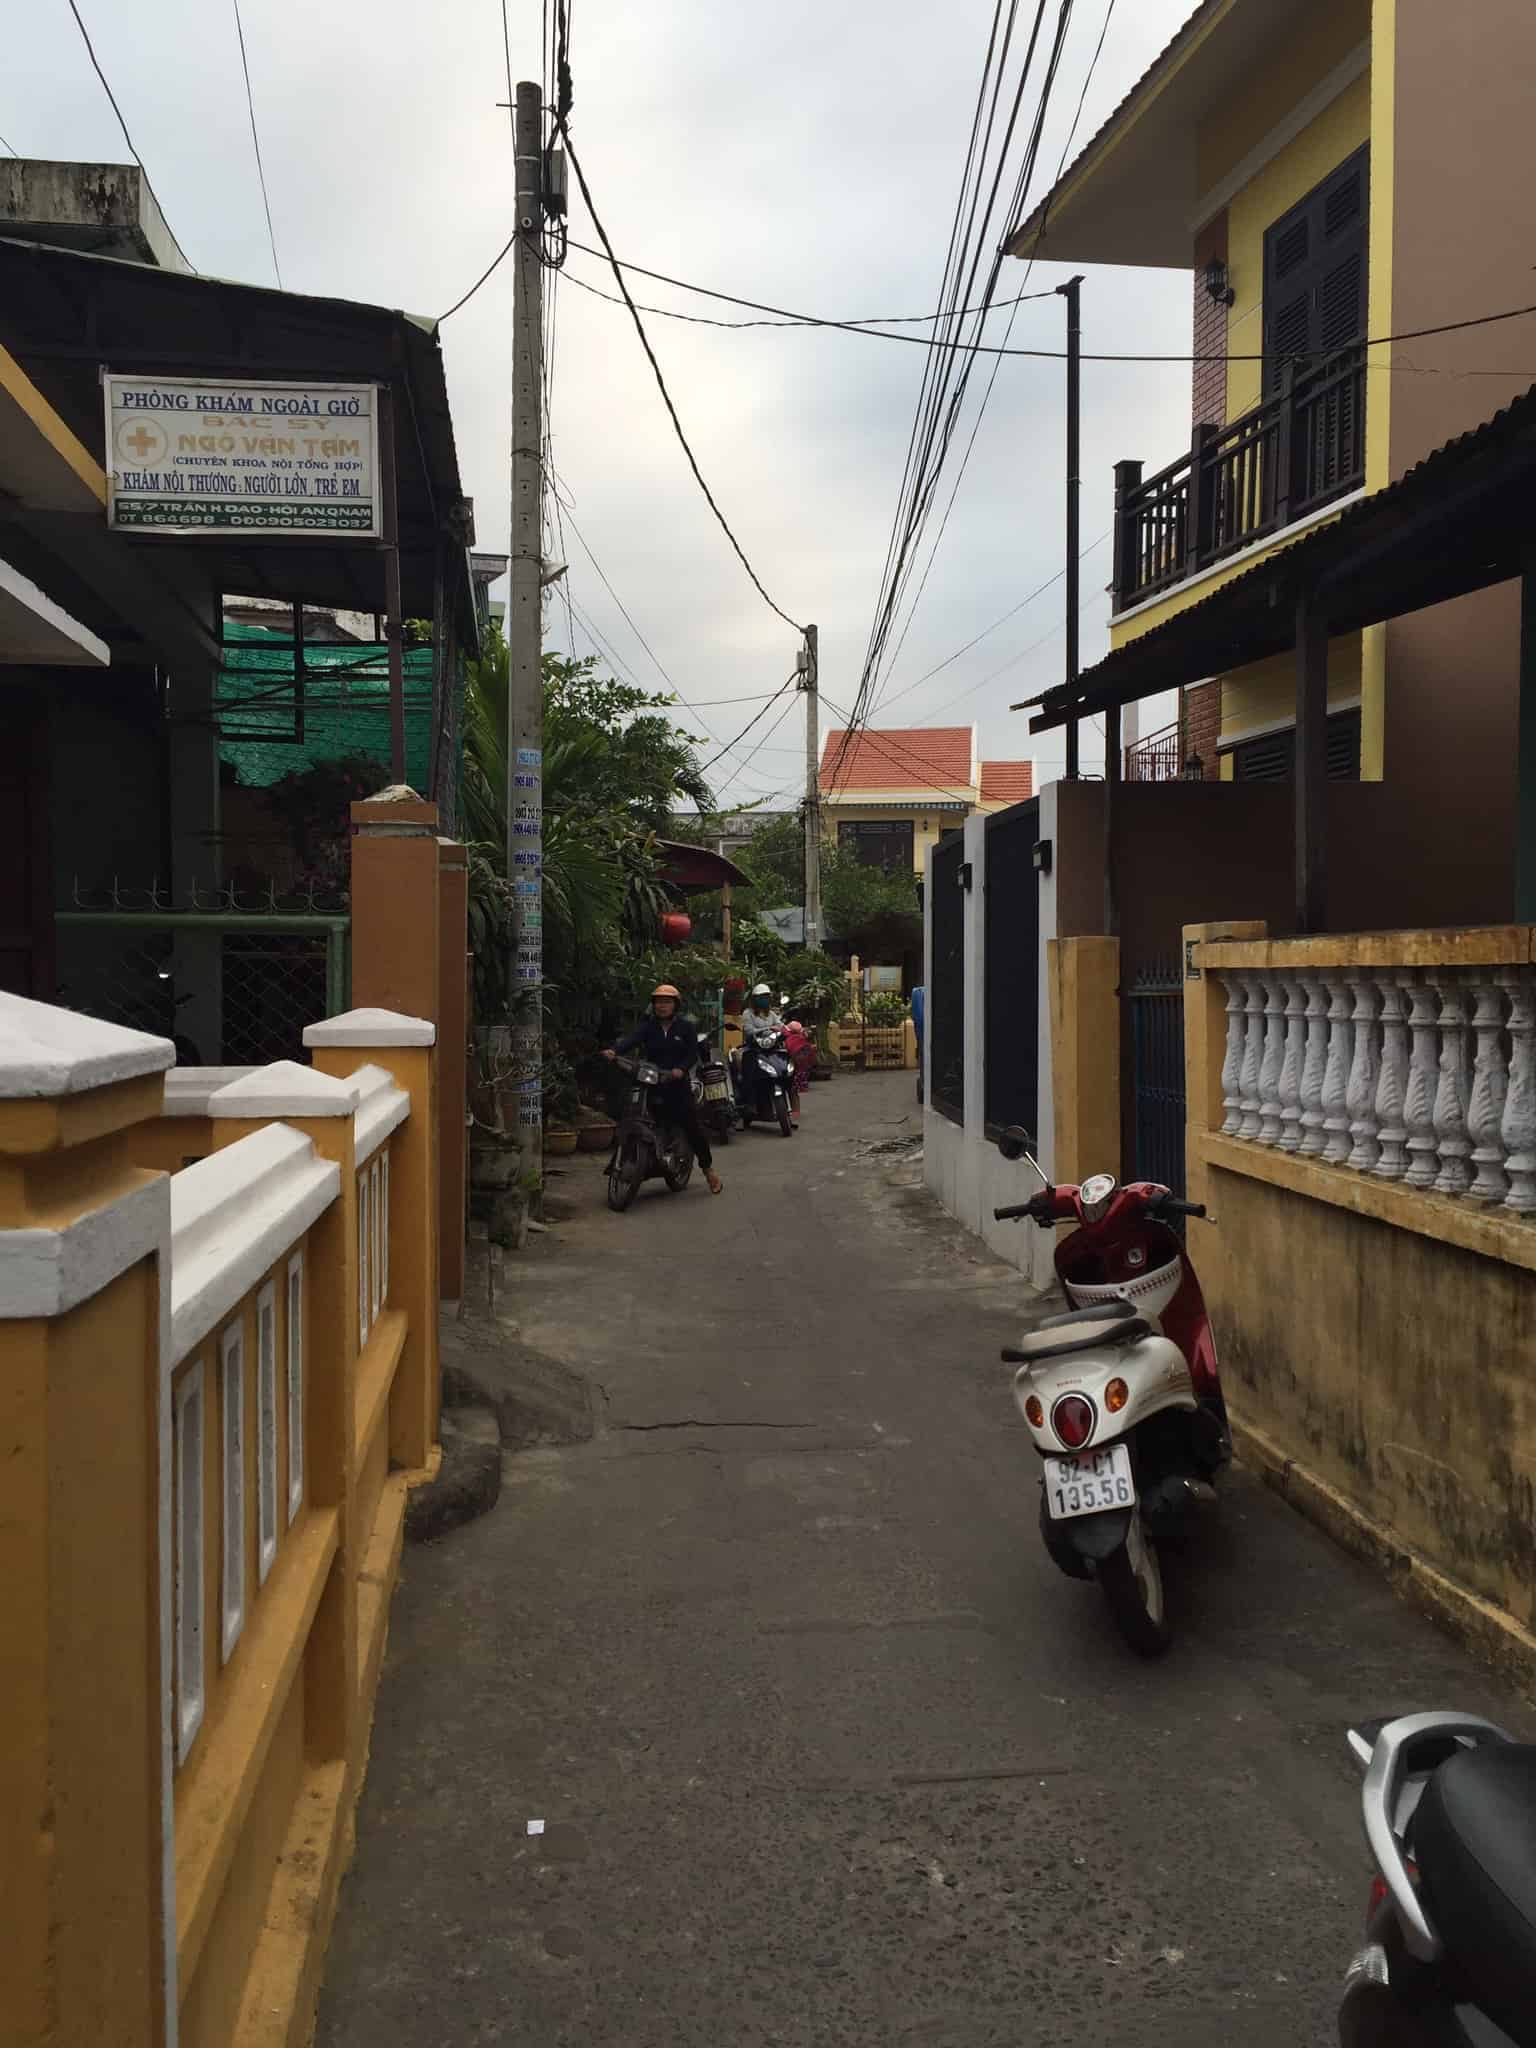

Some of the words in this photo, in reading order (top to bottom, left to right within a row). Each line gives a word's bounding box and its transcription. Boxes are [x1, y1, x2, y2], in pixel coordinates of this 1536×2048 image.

[123, 390, 189, 409] PHÒNG
[197, 393, 252, 412] KHÁM
[262, 395, 320, 414] NGOÀI
[328, 398, 360, 415] GIỜ
[232, 457, 266, 468] KHOA
[343, 480, 360, 496] EM
[1059, 1452, 1115, 1484] 92-C1
[1056, 1478, 1129, 1514] 135.56
